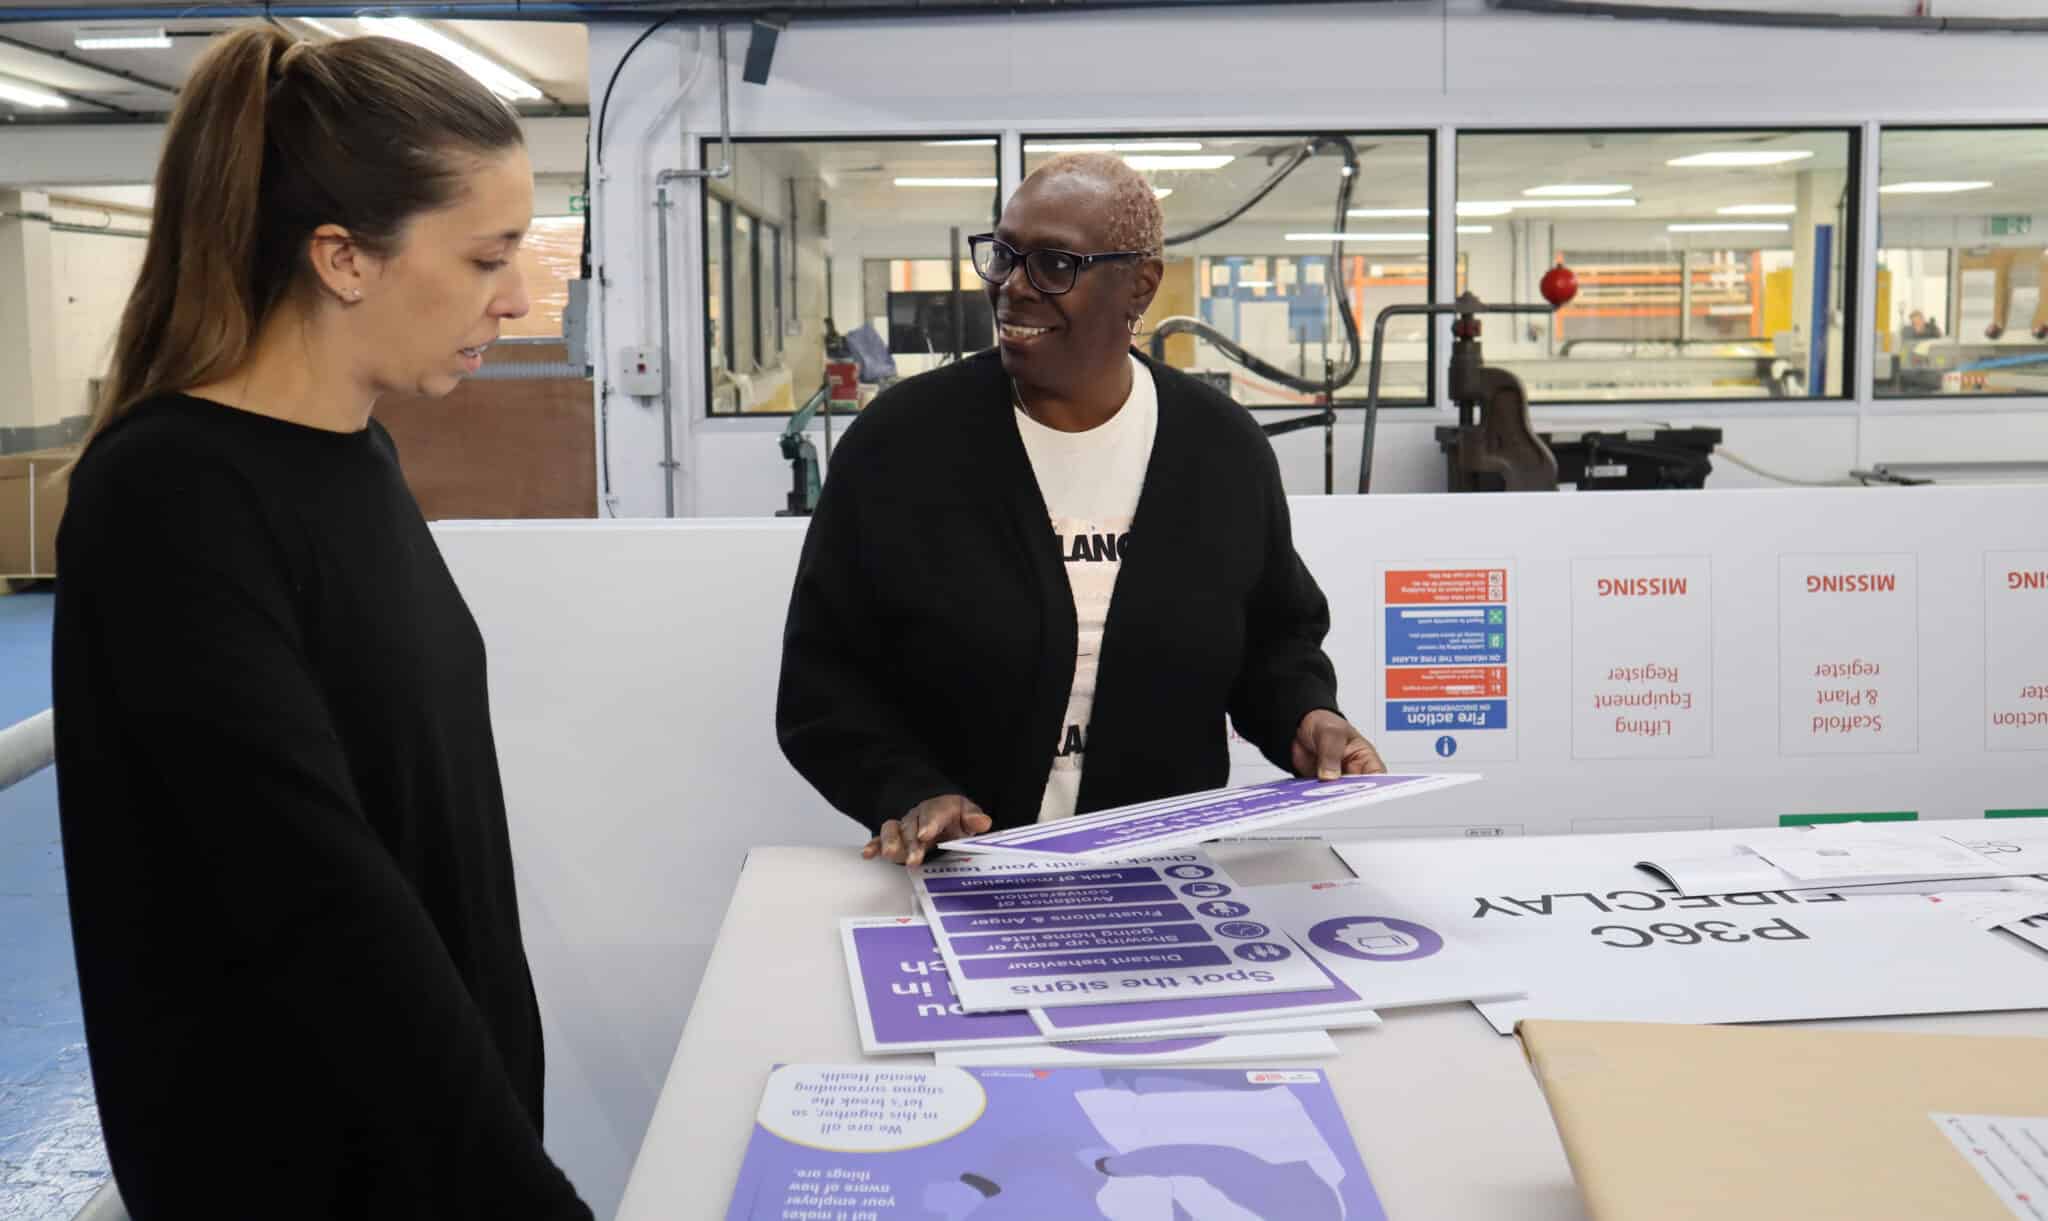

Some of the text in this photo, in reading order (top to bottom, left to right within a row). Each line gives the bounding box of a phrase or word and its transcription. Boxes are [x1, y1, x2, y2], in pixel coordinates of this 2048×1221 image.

[1596, 576, 1688, 597] MISSING
[1806, 573, 1896, 593] MISSING
[1608, 663, 1679, 683] Register
[1814, 659, 1880, 679] register
[1594, 690, 1692, 710] Equipment
[1816, 689, 1878, 706] & Plant
[1407, 712, 1486, 727] Fire action
[1812, 715, 1882, 733] Scaffold
[1615, 716, 1671, 737] Lifting
[989, 861, 1038, 872] your
[960, 876, 1054, 888] motivation
[1020, 895, 1114, 908] Avoidance
[968, 916, 1026, 928] Anger
[1049, 909, 1164, 922] Frustrations
[1000, 935, 1037, 944] late
[1041, 931, 1096, 942] home
[1590, 917, 1811, 949] P36C
[1012, 940, 1060, 952] early
[1065, 939, 1090, 948] up
[1094, 935, 1179, 946] Showing
[1007, 954, 1182, 971] Distant behaviour
[1008, 969, 1275, 996] Spot the signs
[891, 981, 934, 998] in
[874, 1072, 927, 1083] Mental
[793, 1081, 887, 1095] surrounding
[809, 1097, 836, 1108] the
[840, 1097, 885, 1108] break
[888, 1111, 918, 1121] this
[820, 1123, 903, 1135] We are all
[826, 1167, 871, 1182] things
[787, 1182, 890, 1194] aware of how
[785, 1194, 896, 1209] your employer
[783, 1210, 832, 1221] makes
